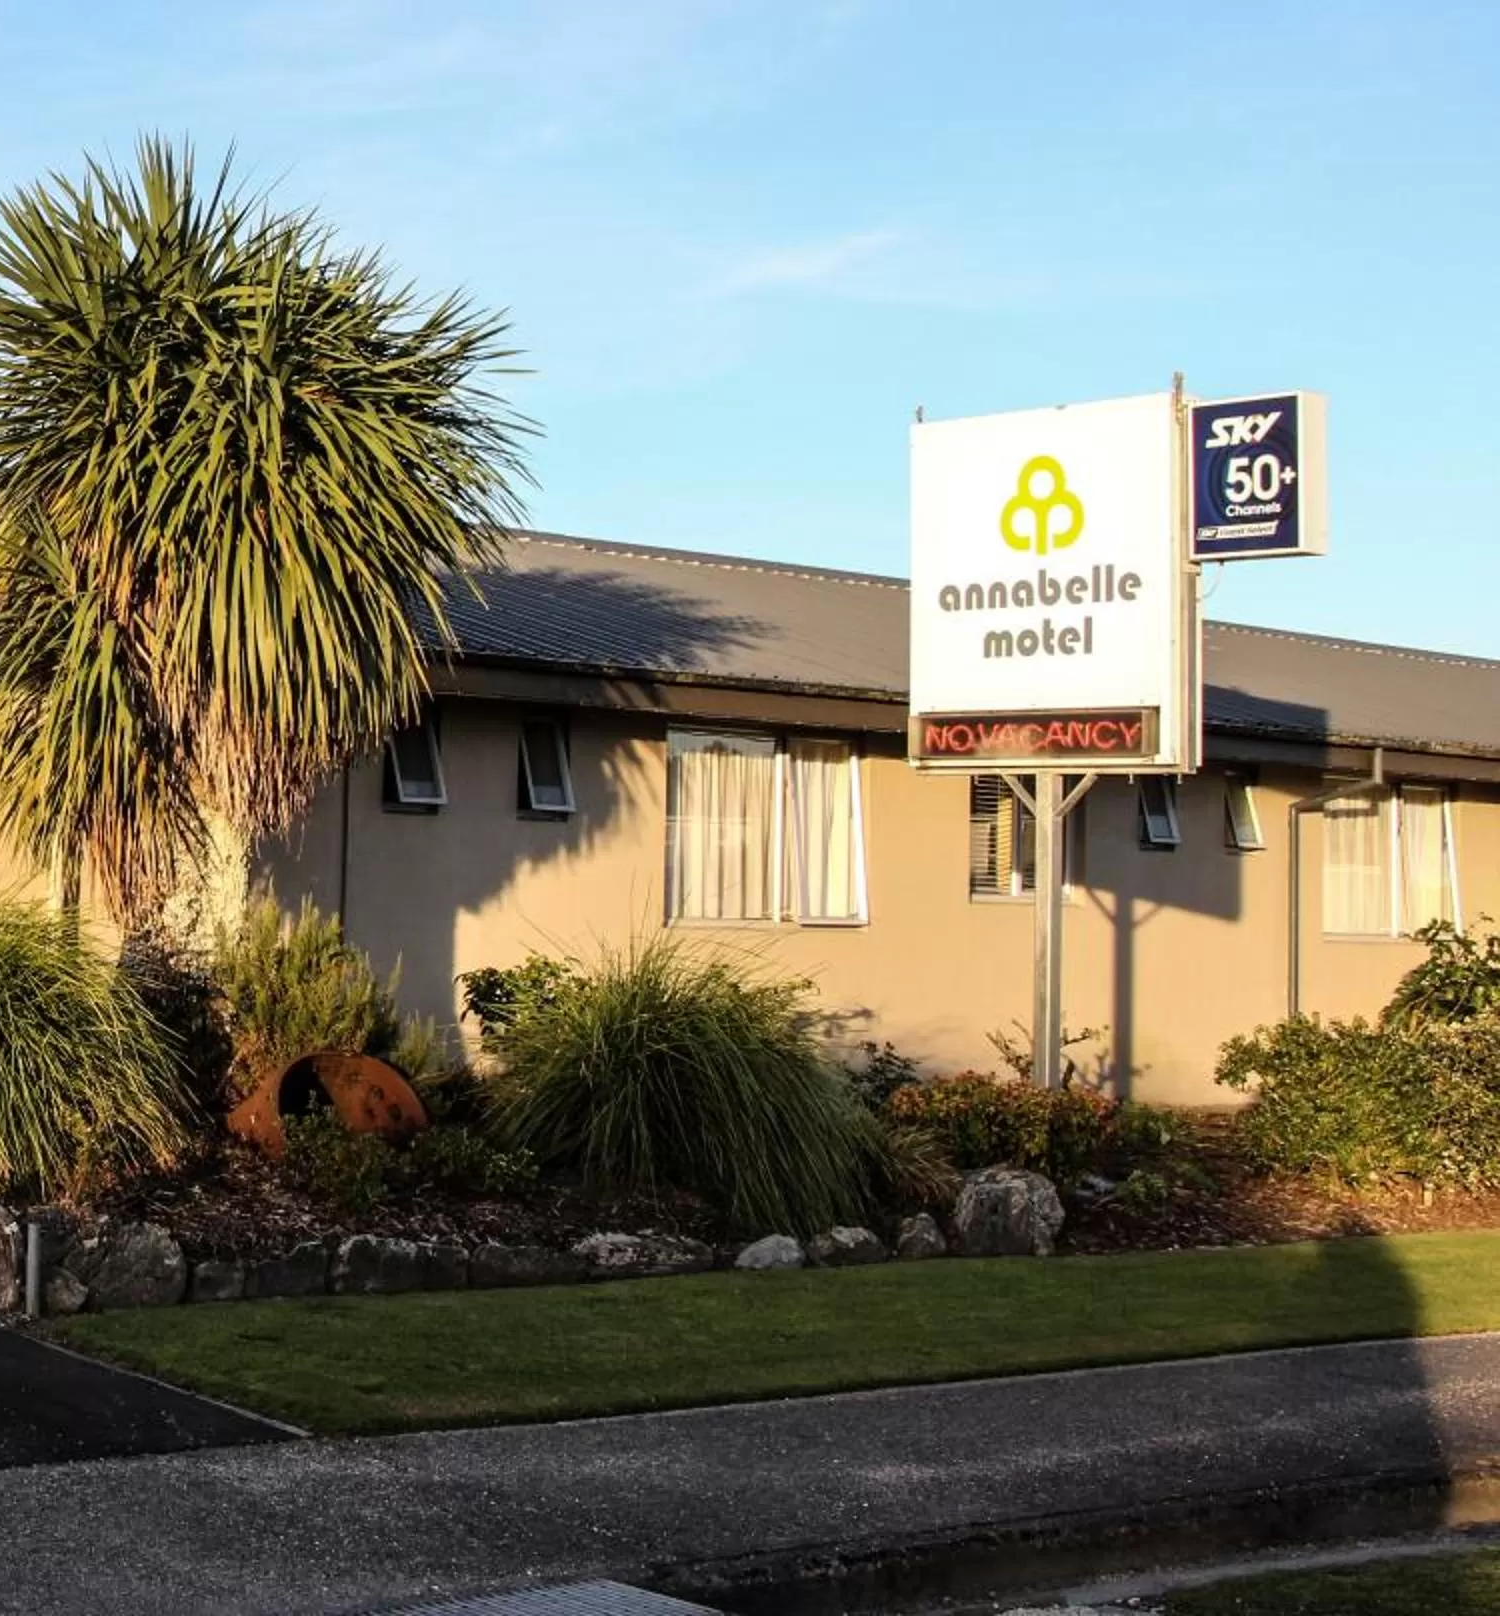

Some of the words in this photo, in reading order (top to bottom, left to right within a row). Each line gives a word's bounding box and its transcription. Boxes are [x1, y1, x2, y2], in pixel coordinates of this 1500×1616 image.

[1225, 502, 1282, 517] Channels
[939, 564, 1142, 612] annabelle
[983, 617, 1093, 658] motel
